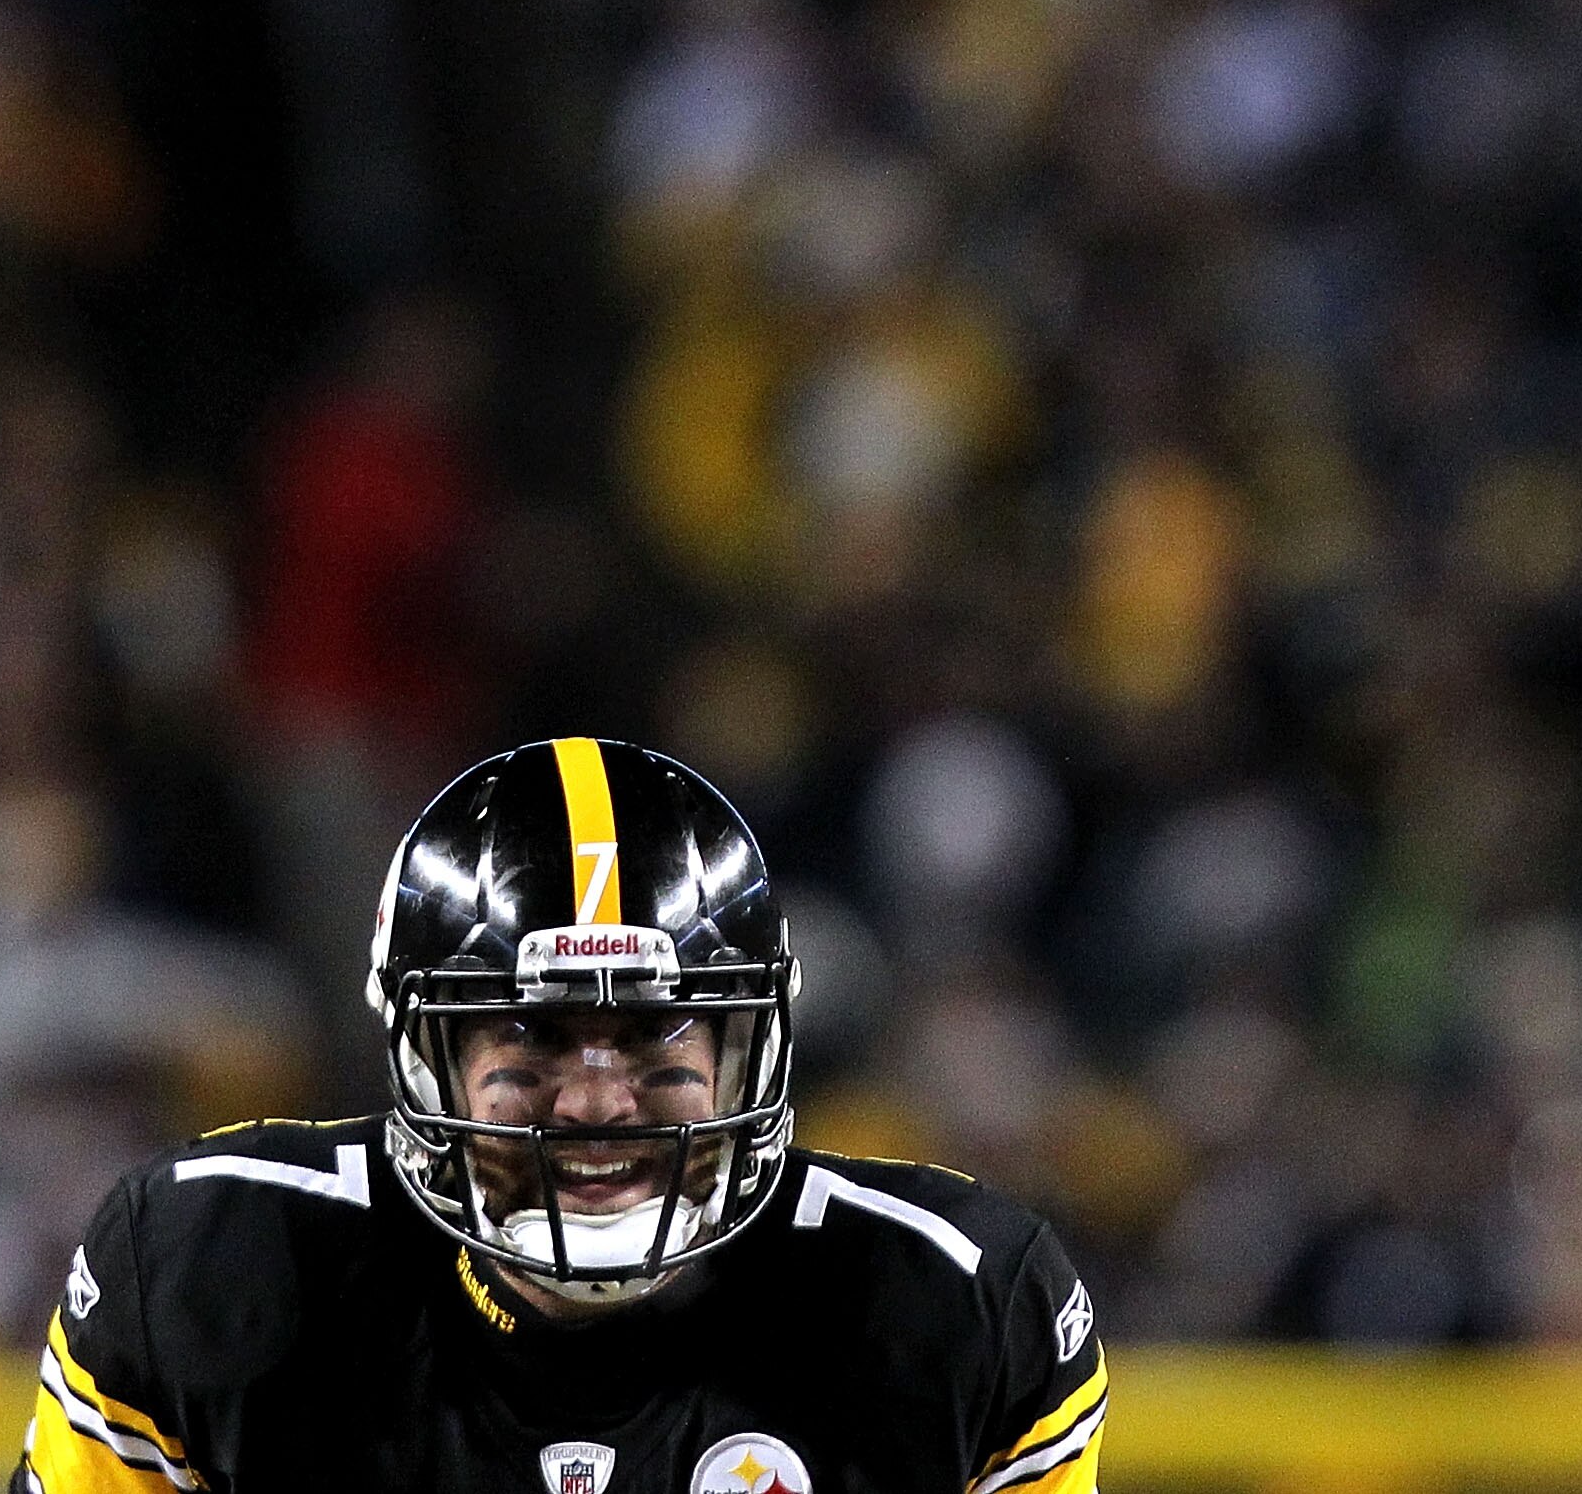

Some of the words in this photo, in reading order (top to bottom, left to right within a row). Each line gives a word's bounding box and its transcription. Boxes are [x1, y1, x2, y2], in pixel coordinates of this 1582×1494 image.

[576, 841, 618, 925] 7
[555, 933, 639, 956] Riddell
[173, 1143, 371, 1209] 7
[792, 1164, 983, 1276] 7
